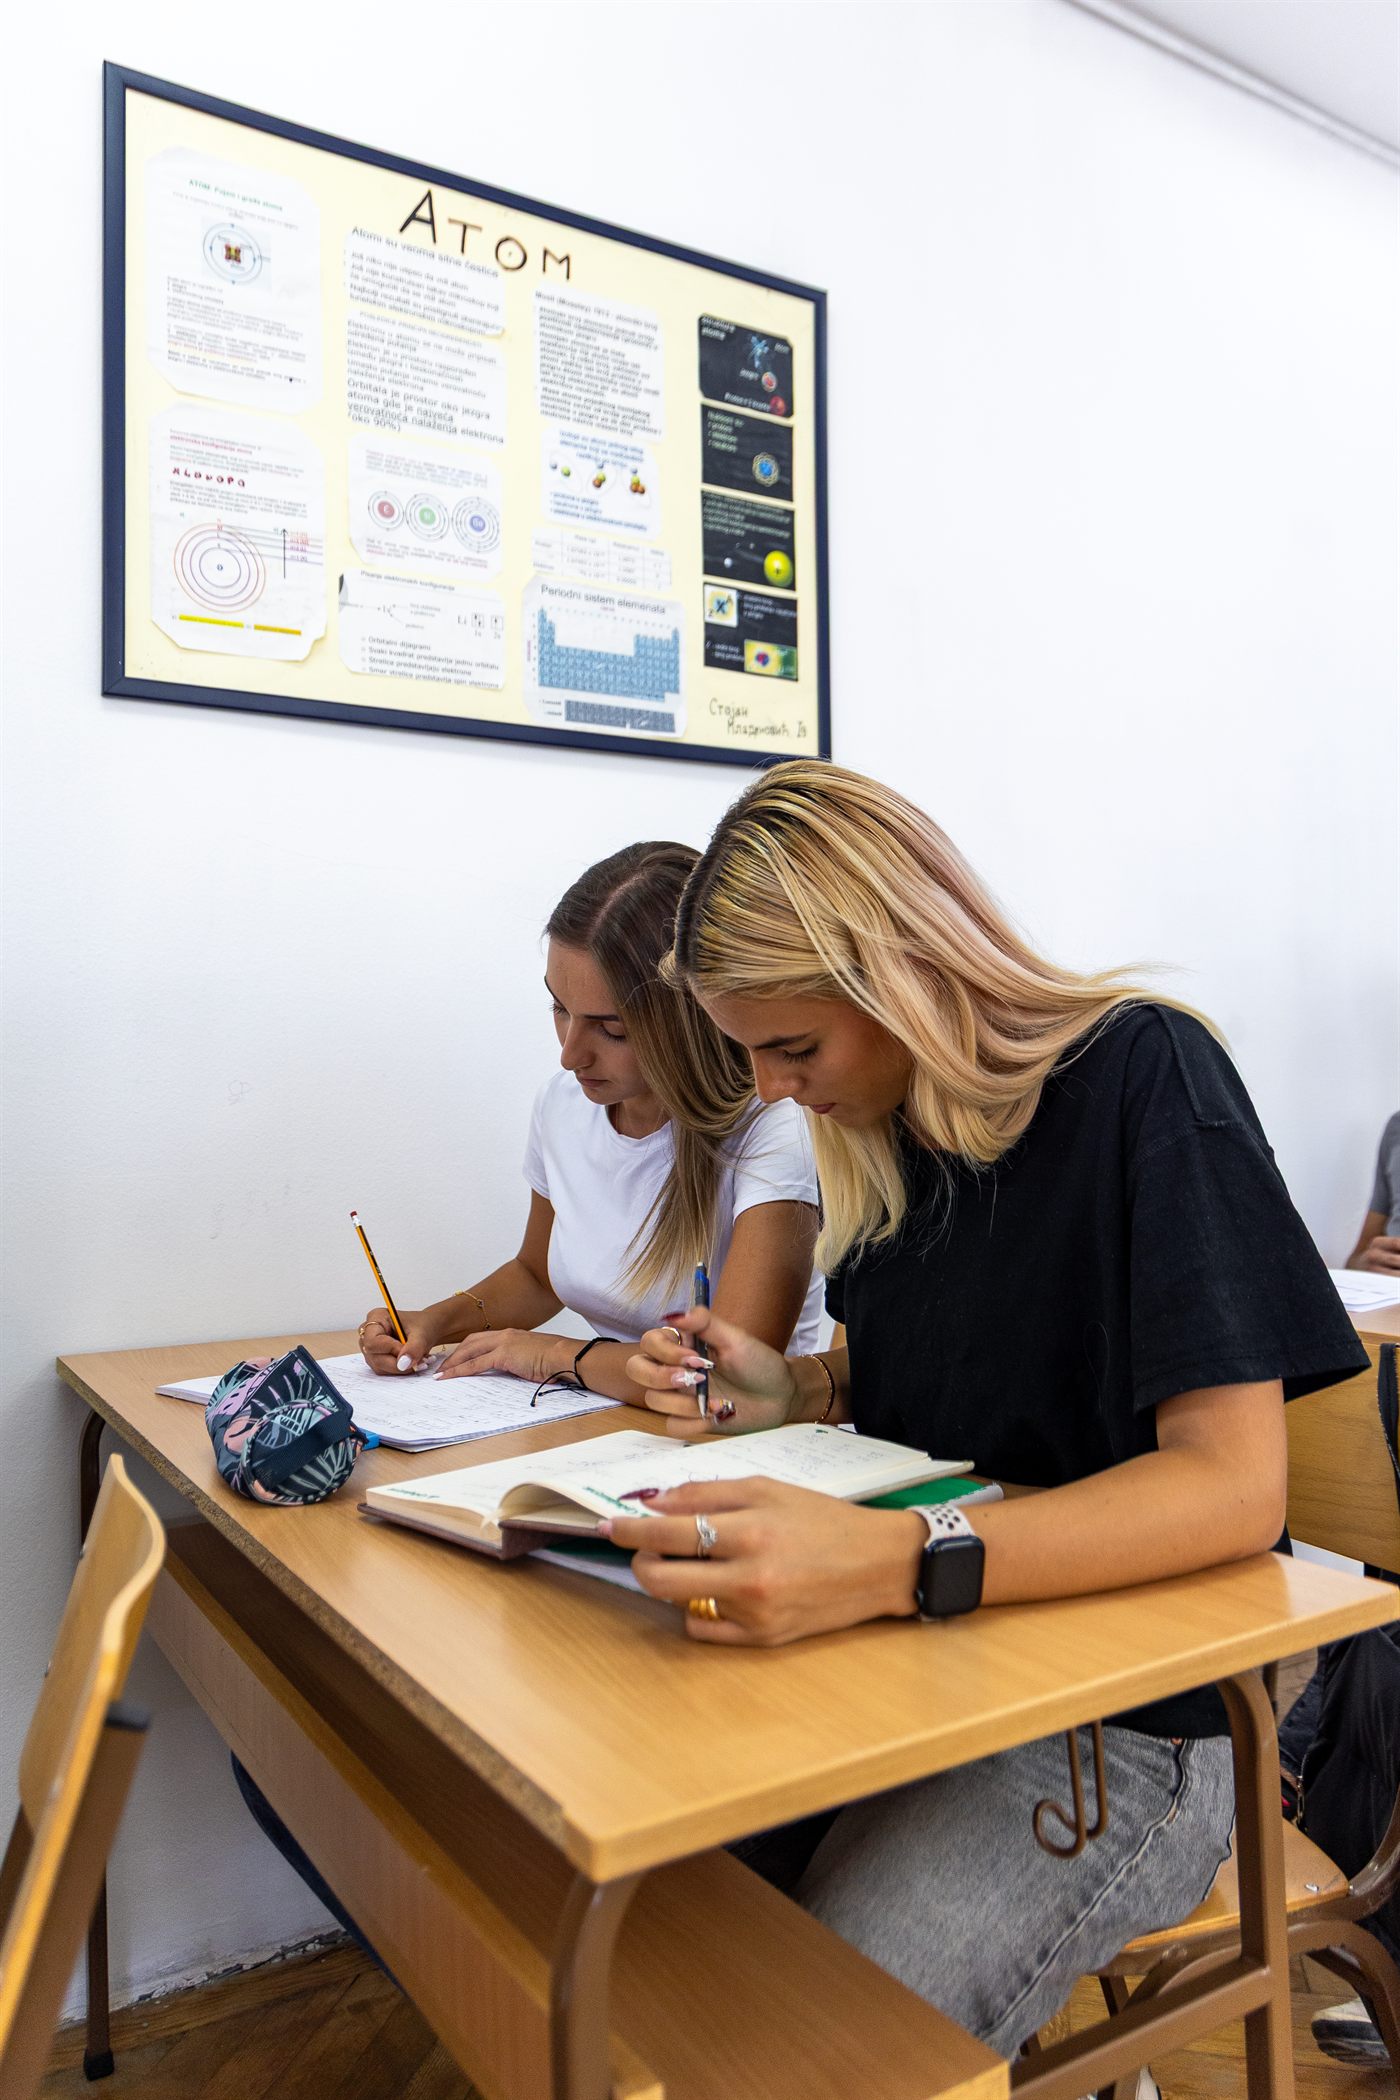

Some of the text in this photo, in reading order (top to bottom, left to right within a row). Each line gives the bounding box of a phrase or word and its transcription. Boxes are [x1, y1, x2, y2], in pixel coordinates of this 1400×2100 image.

[351, 226, 382, 243] Atomi
[385, 237, 398, 248] su
[401, 244, 435, 260] veoma
[399, 188, 570, 281] ATOM
[347, 378, 490, 420] Orbitala je prostor oko jezgra
[347, 391, 379, 404] atoma
[382, 398, 401, 409] gde
[404, 403, 414, 413] je
[460, 428, 504, 443] elektrona
[540, 584, 666, 614] Periodni sistem elemenata
[388, 649, 414, 658] kvadrat
